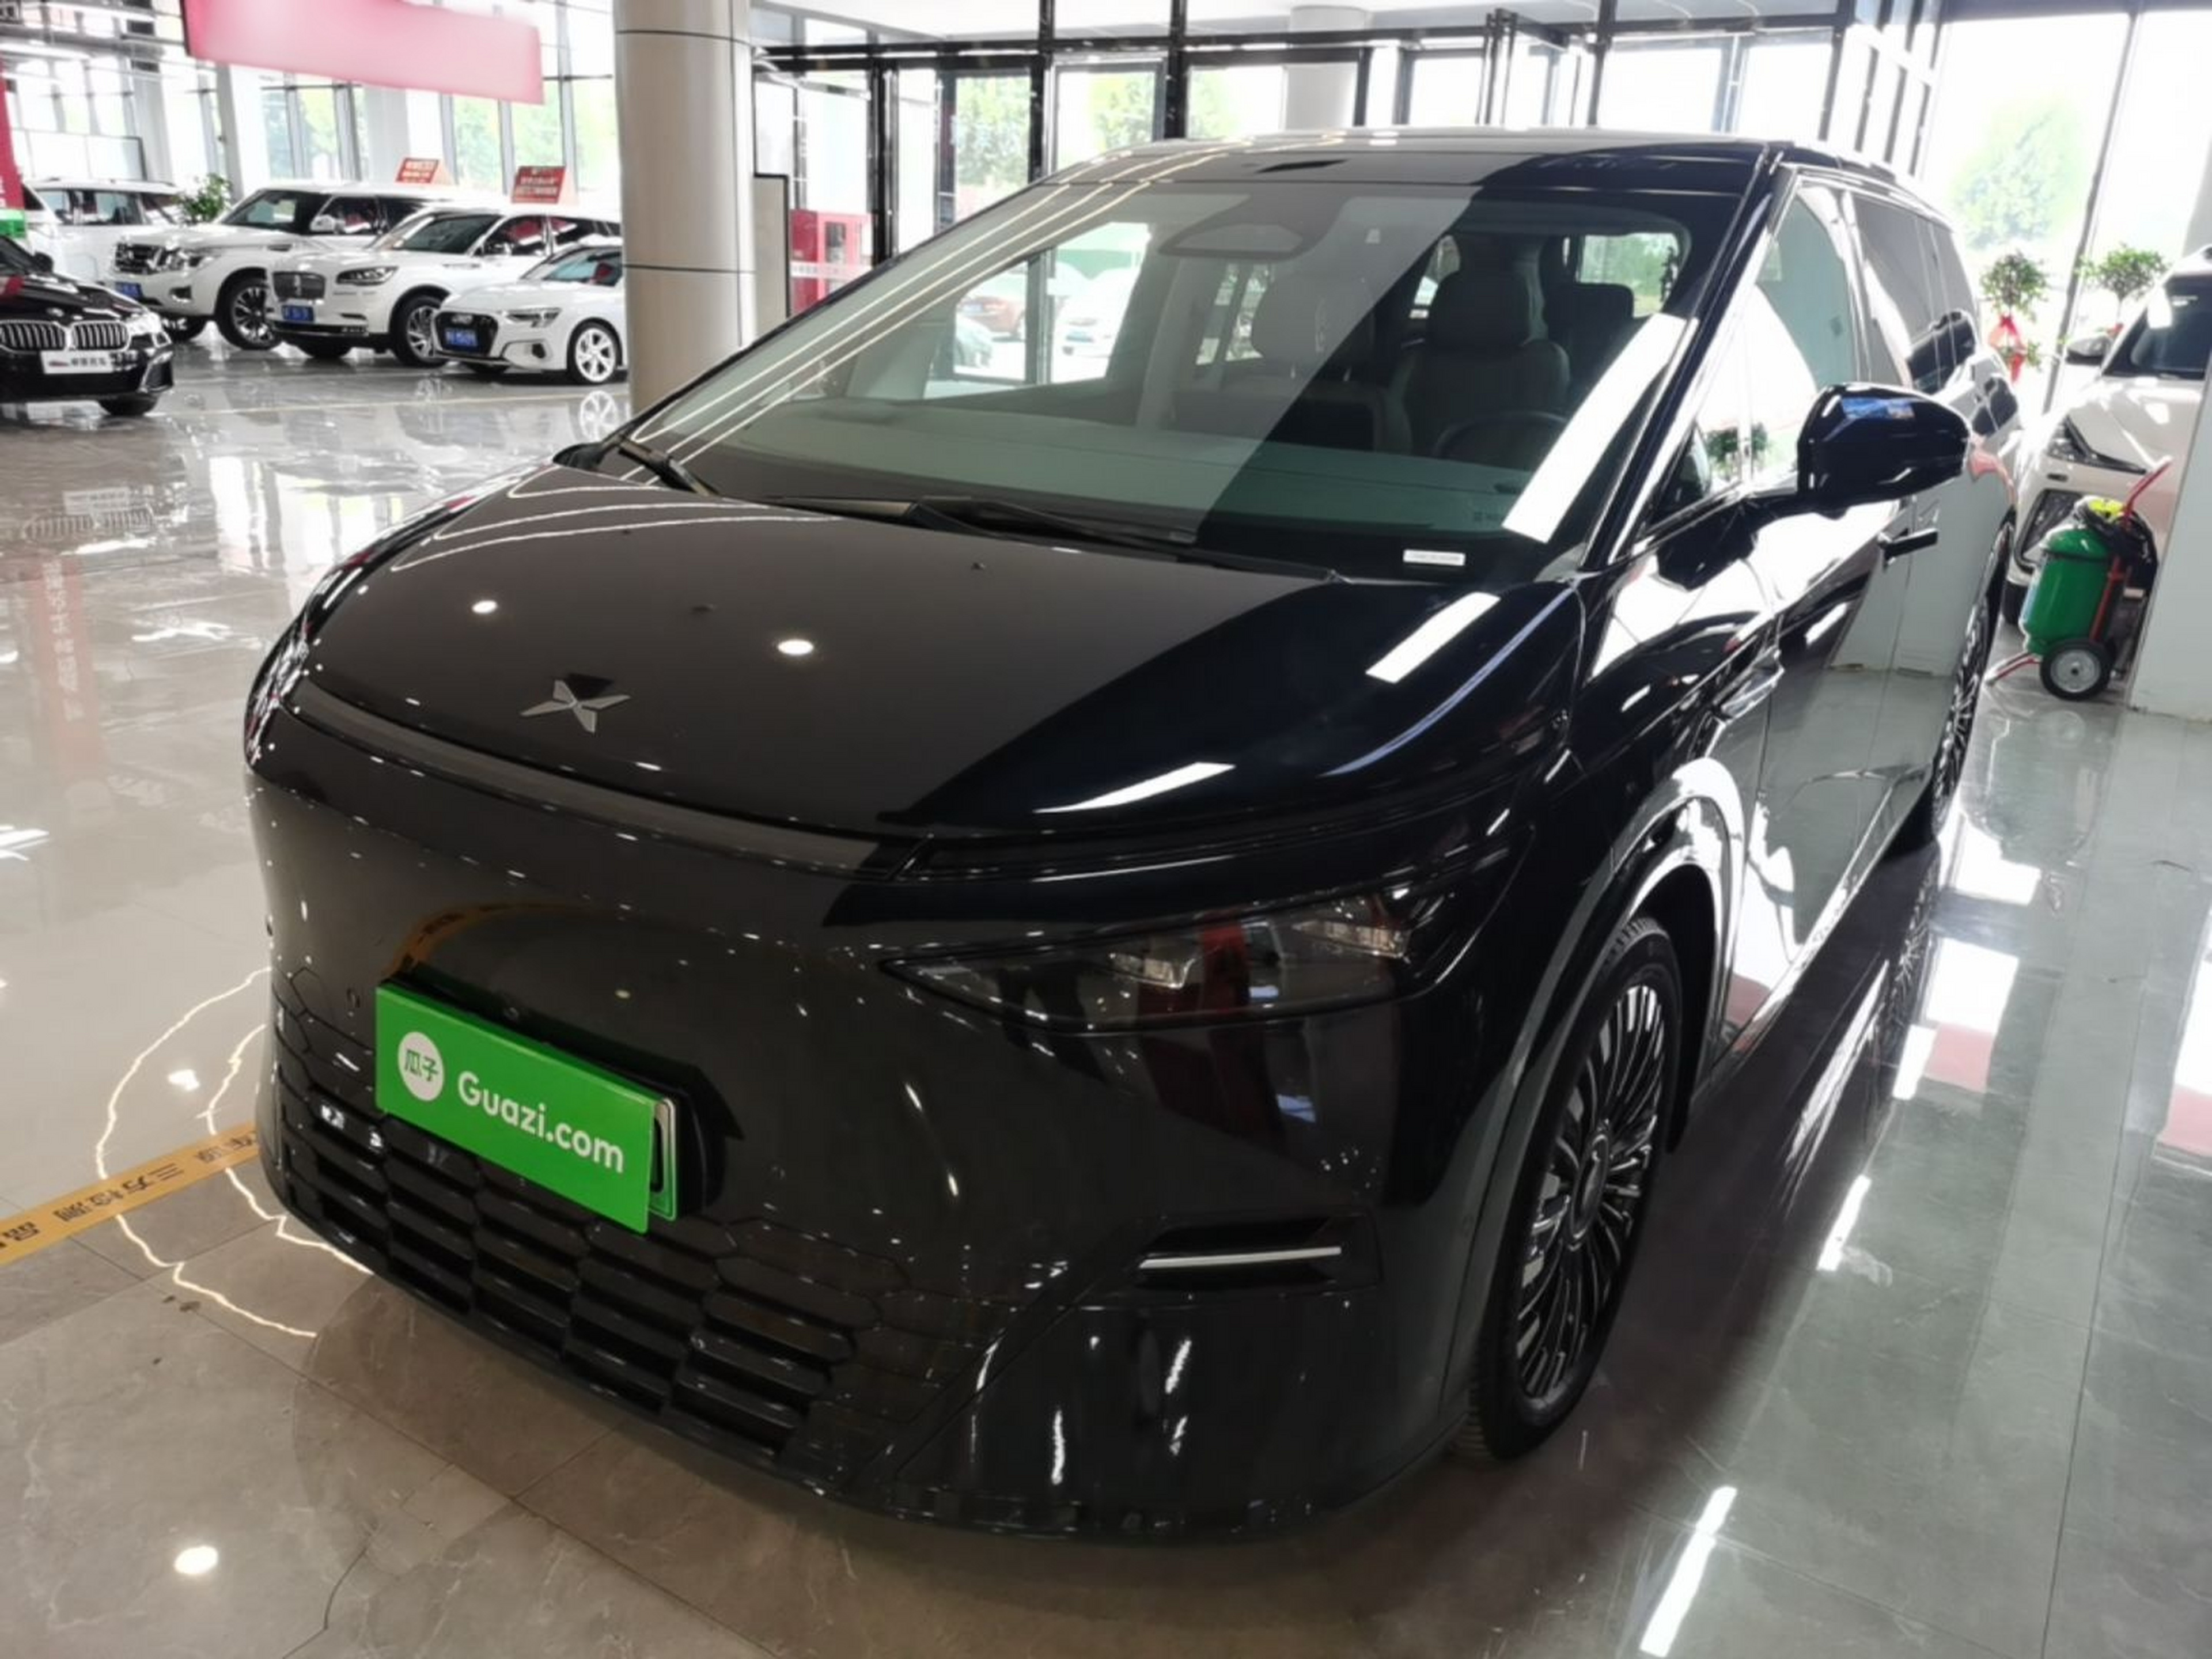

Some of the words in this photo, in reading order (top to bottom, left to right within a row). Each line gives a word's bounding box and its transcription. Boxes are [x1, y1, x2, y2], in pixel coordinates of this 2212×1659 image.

[403, 1048, 440, 1083] 瓜子
[457, 1071, 624, 1175] Guazi.com
[0, 1221, 40, 1250] 品
